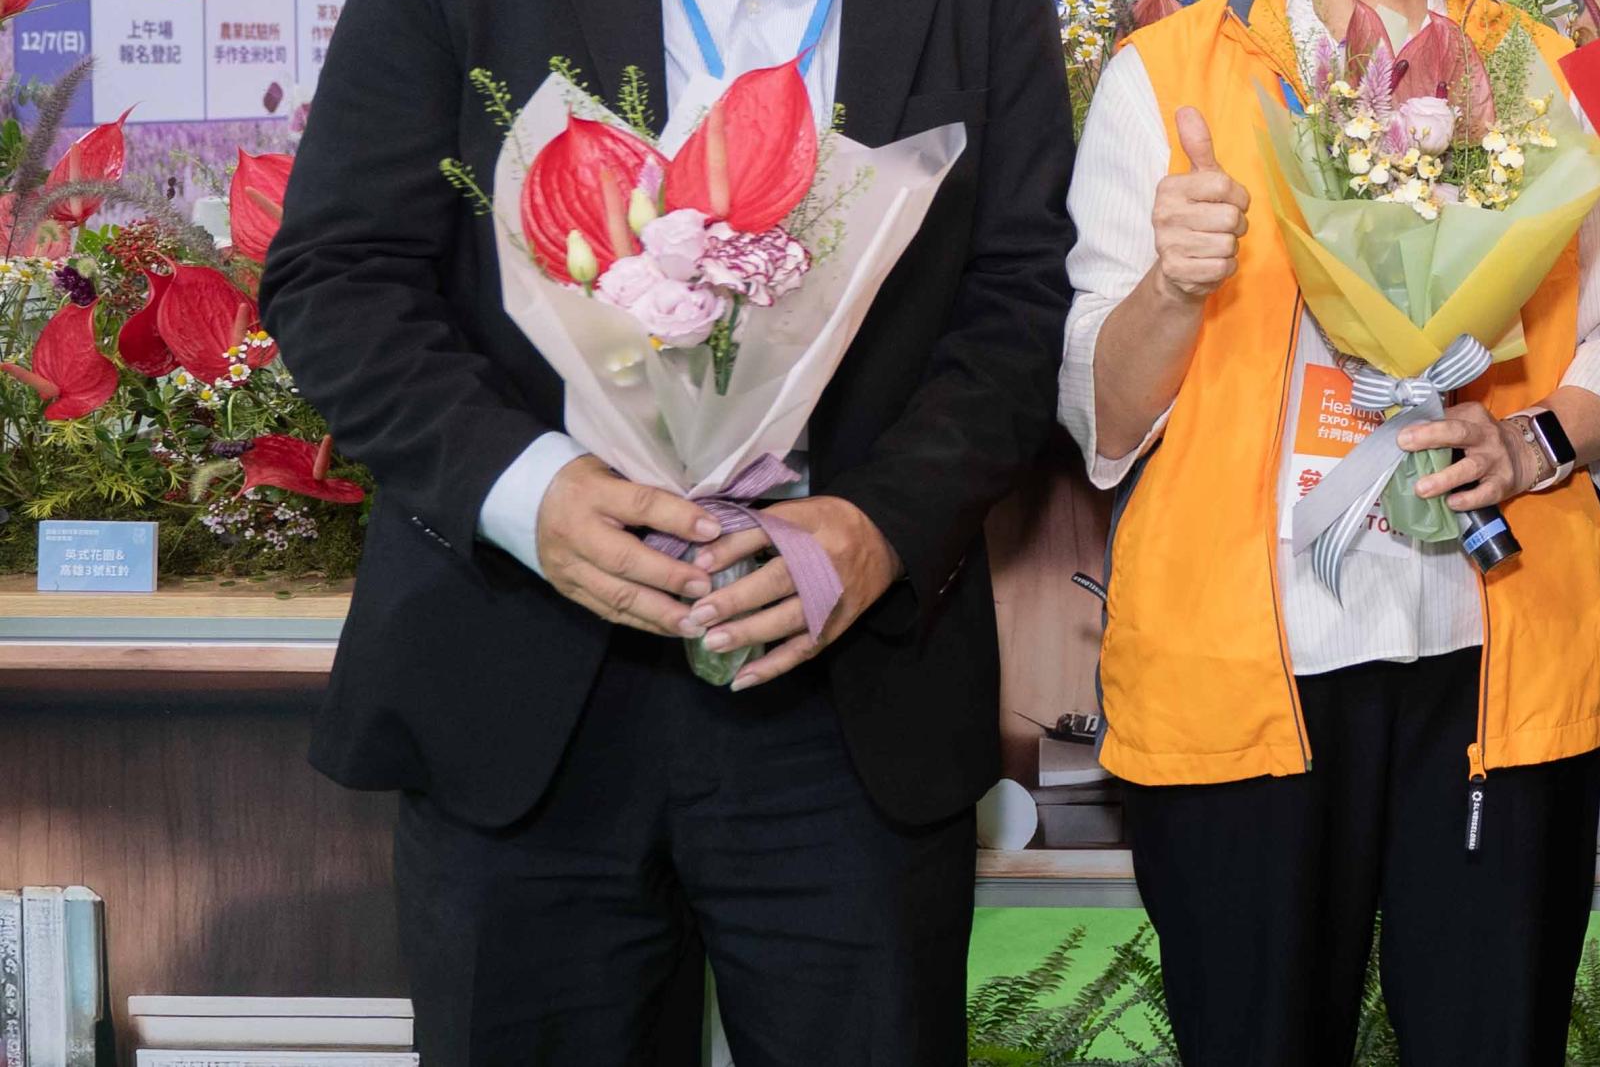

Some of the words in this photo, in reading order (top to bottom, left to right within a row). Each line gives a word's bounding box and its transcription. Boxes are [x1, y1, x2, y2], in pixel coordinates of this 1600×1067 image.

[22, 31, 86, 54] 12/7(日)
[119, 44, 181, 65] 報名登記
[213, 45, 287, 65] 手作全米吐司
[1319, 414, 1349, 427] EXPO
